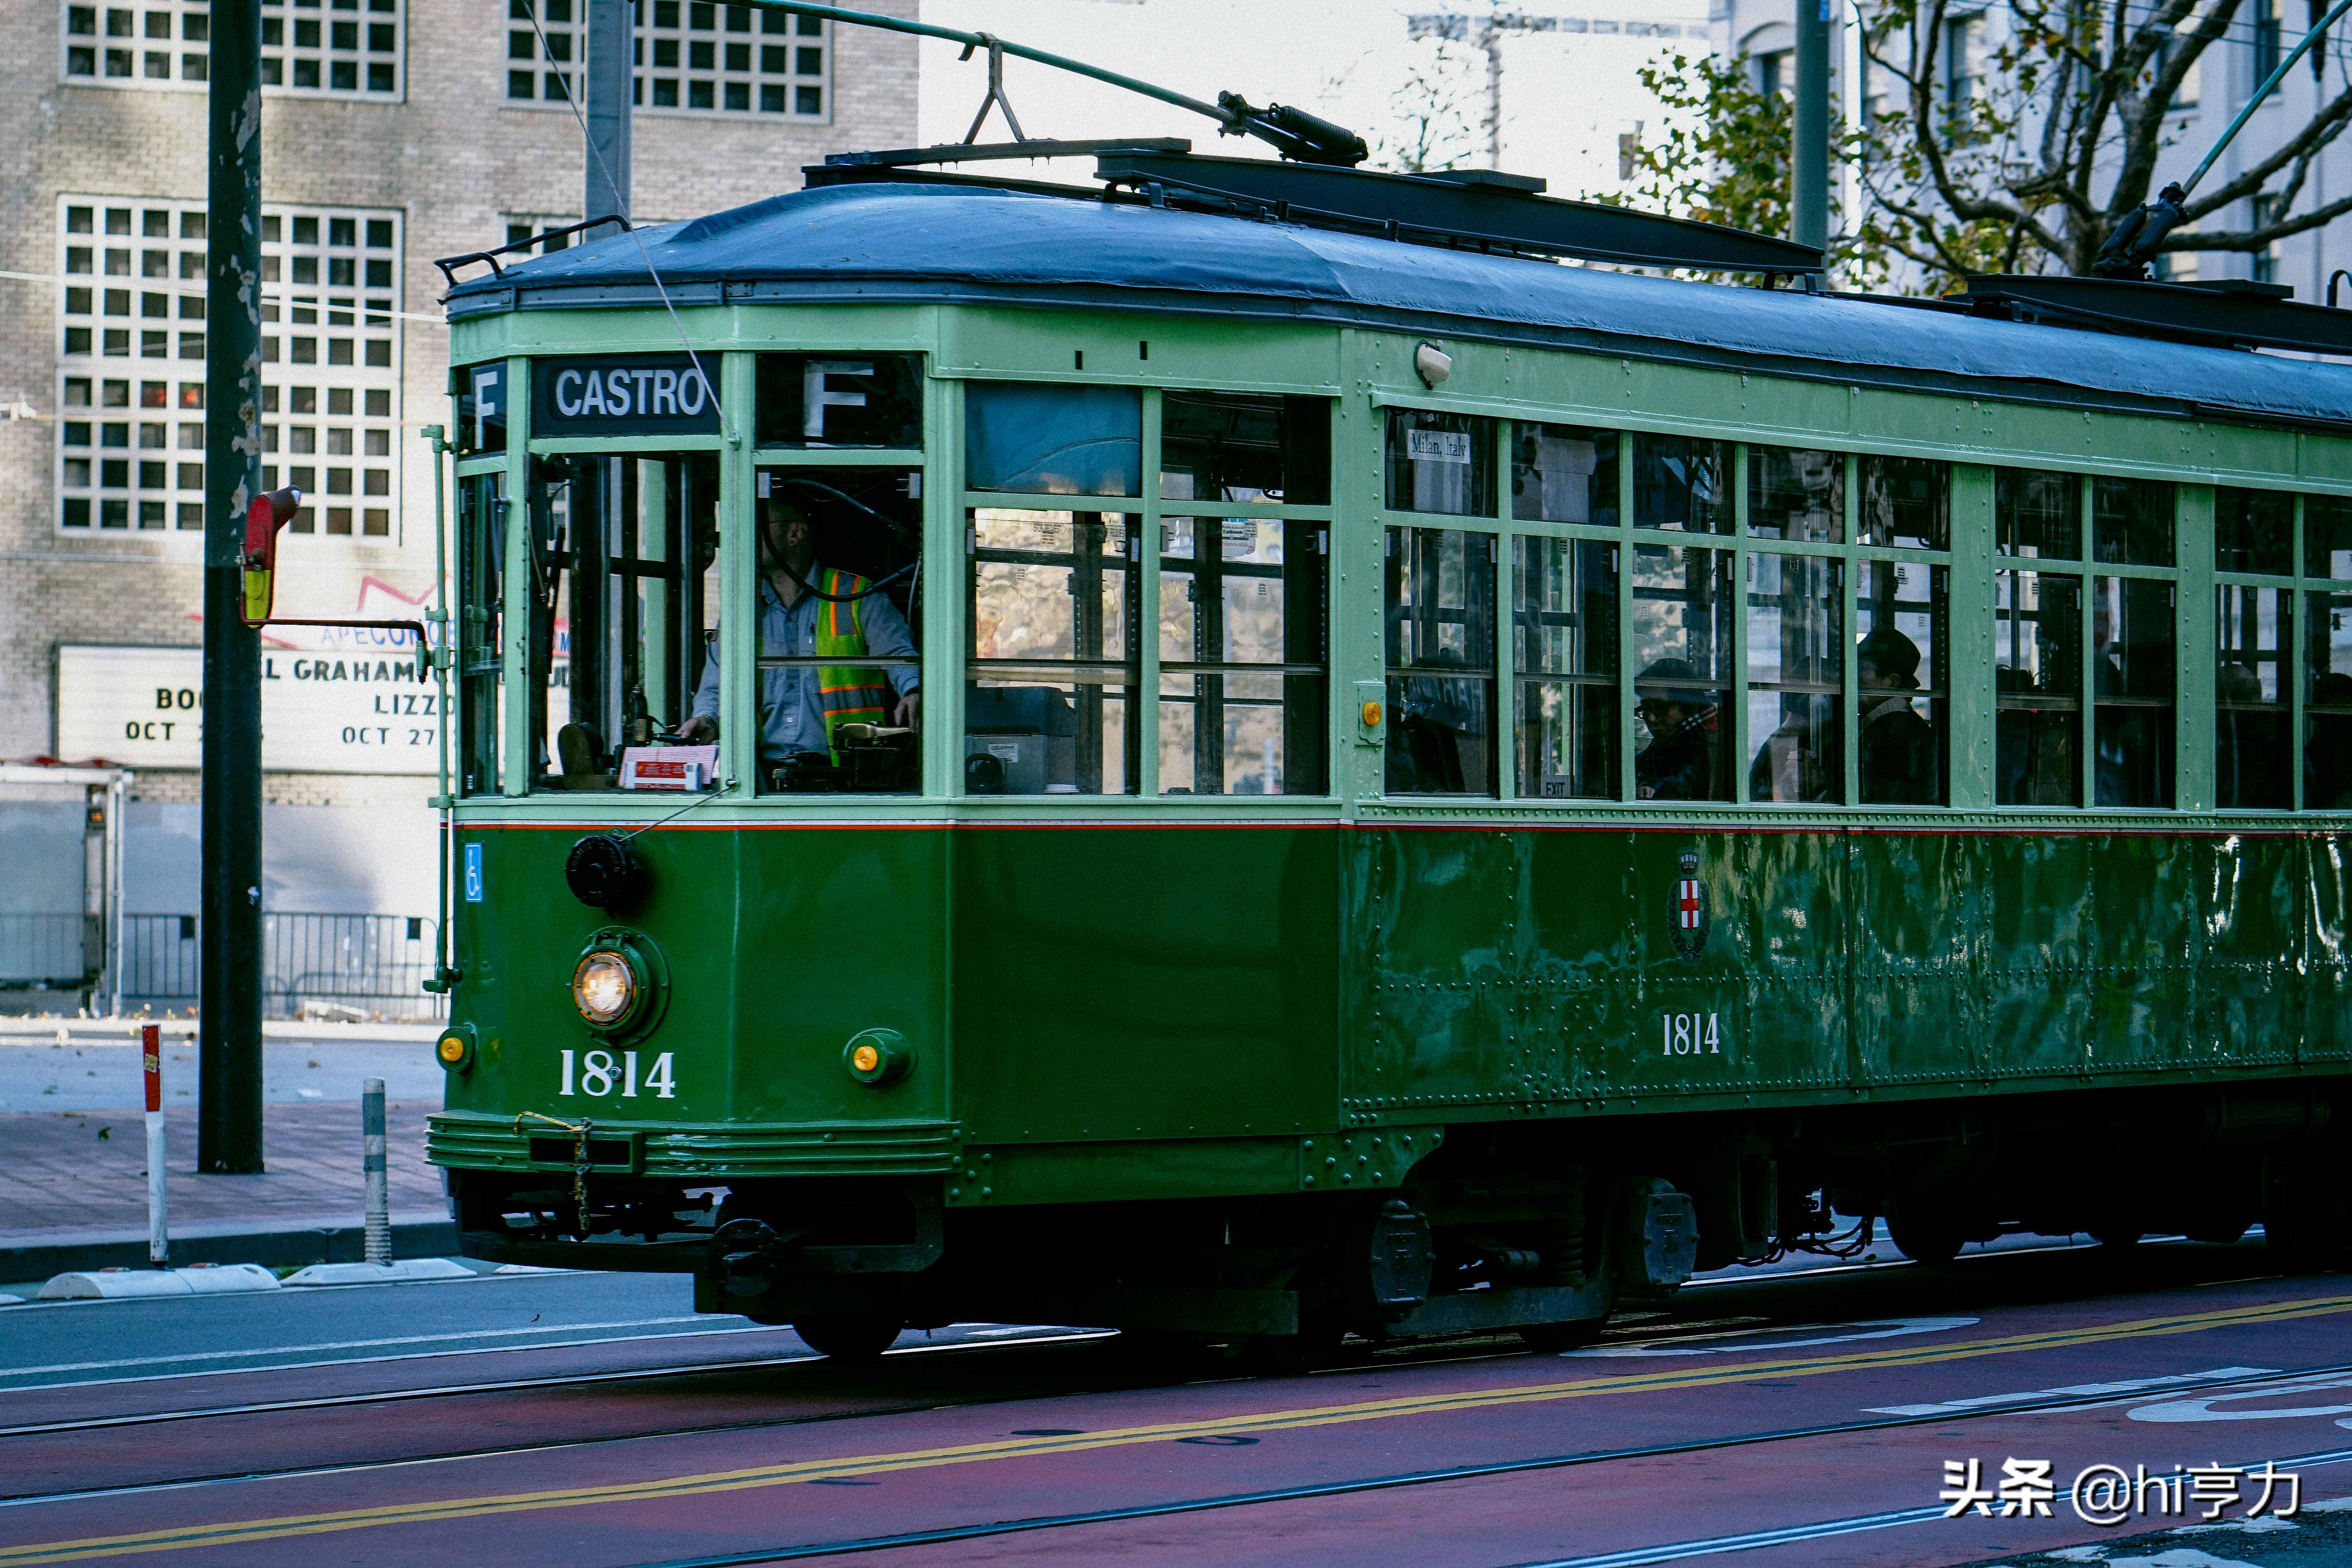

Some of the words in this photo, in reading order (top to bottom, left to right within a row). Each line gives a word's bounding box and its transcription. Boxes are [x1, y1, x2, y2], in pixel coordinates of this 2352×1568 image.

[555, 368, 705, 417] CASTRO
[802, 359, 875, 437] F
[475, 371, 498, 449] F
[1412, 433, 1442, 458] Milan,
[1446, 436, 1467, 461] Italy
[294, 659, 414, 682] GRAHAM
[156, 688, 203, 710] BO
[126, 721, 175, 740] OCT
[342, 726, 390, 745] OCT
[408, 728, 435, 745] 27
[1546, 782, 1565, 796] EXIT
[1663, 1013, 1720, 1056] 1814
[559, 1049, 677, 1098] 1814
